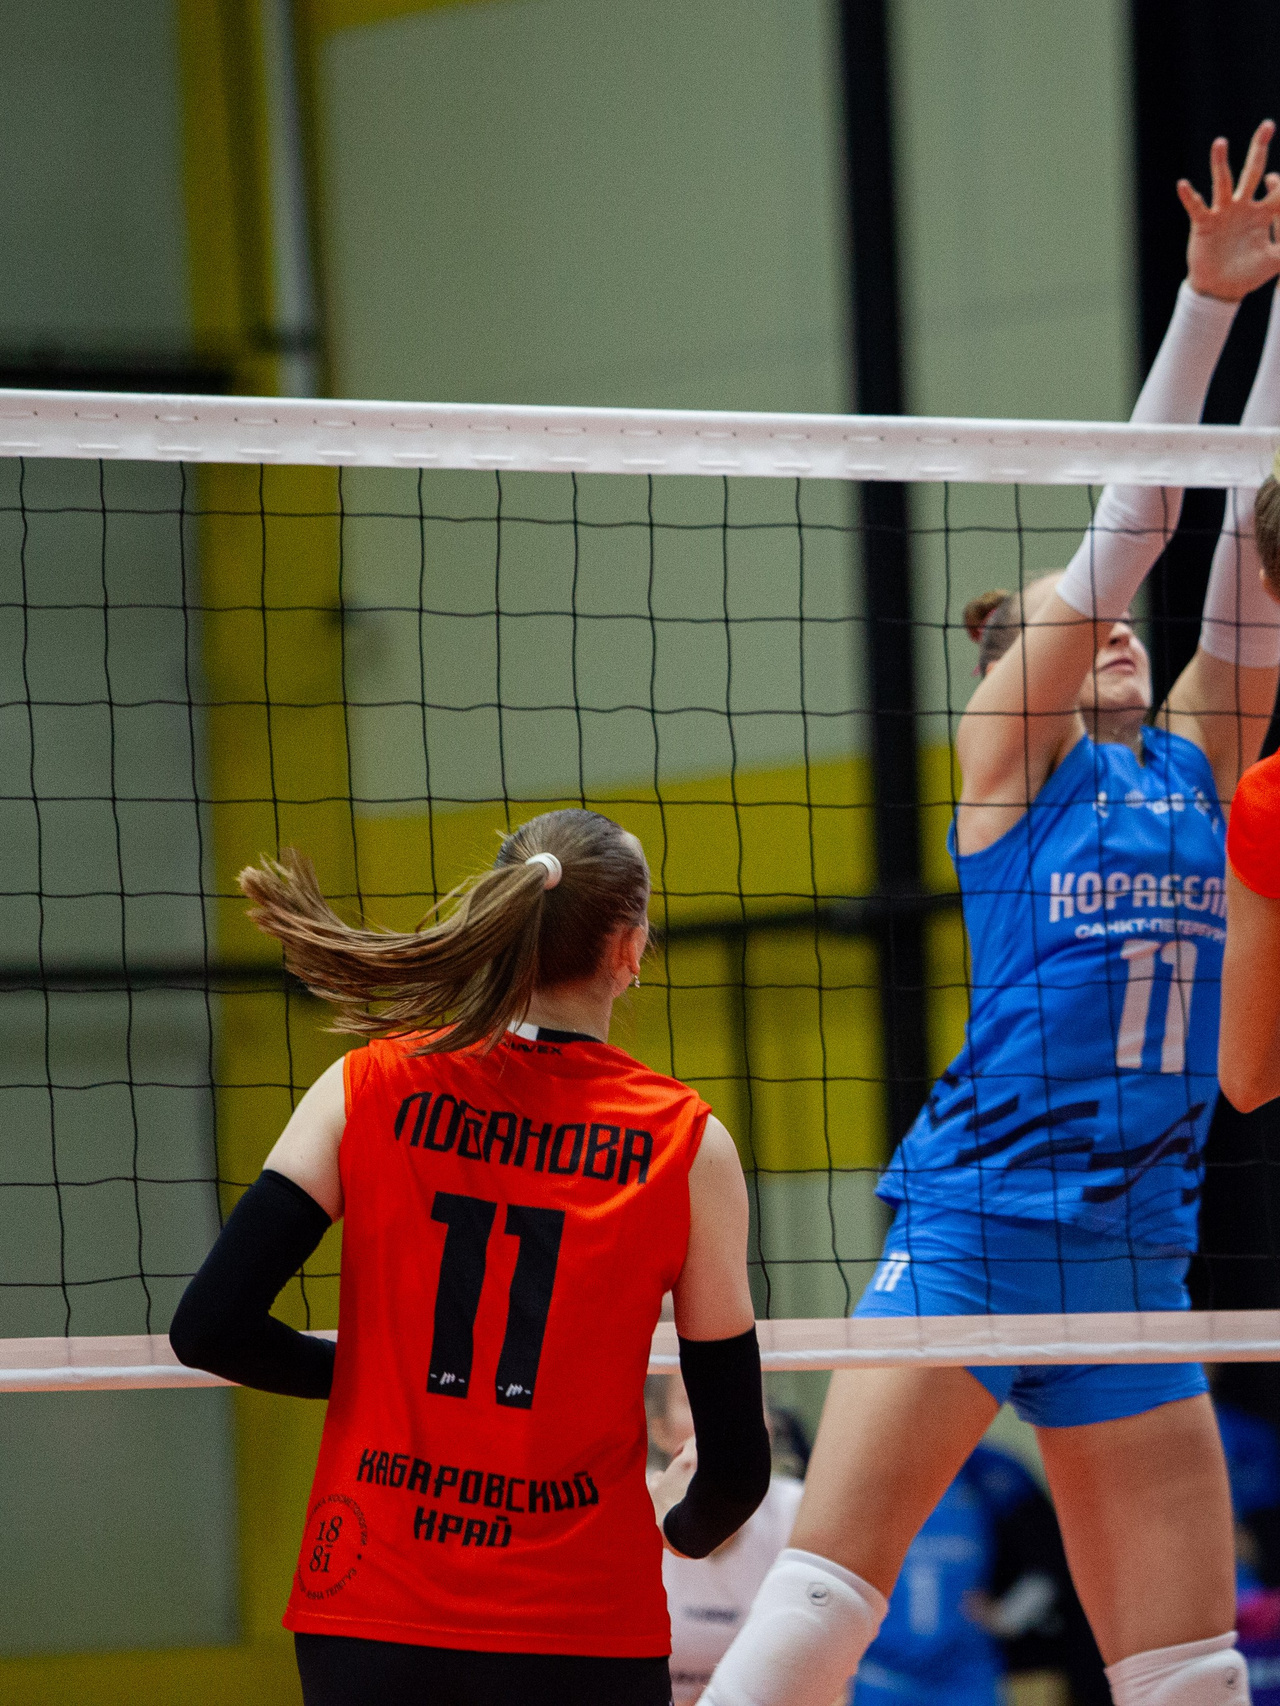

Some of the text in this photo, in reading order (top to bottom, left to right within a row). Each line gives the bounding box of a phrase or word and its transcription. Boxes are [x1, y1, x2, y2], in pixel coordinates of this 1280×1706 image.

[1116, 939, 1198, 1074] 11
[394, 1091, 653, 1186] ЛОБАНОВА
[426, 1191, 566, 1410] 11
[309, 1545, 331, 1573] 81
[316, 1515, 343, 1542] 18
[413, 1505, 513, 1548] КРАЙ
